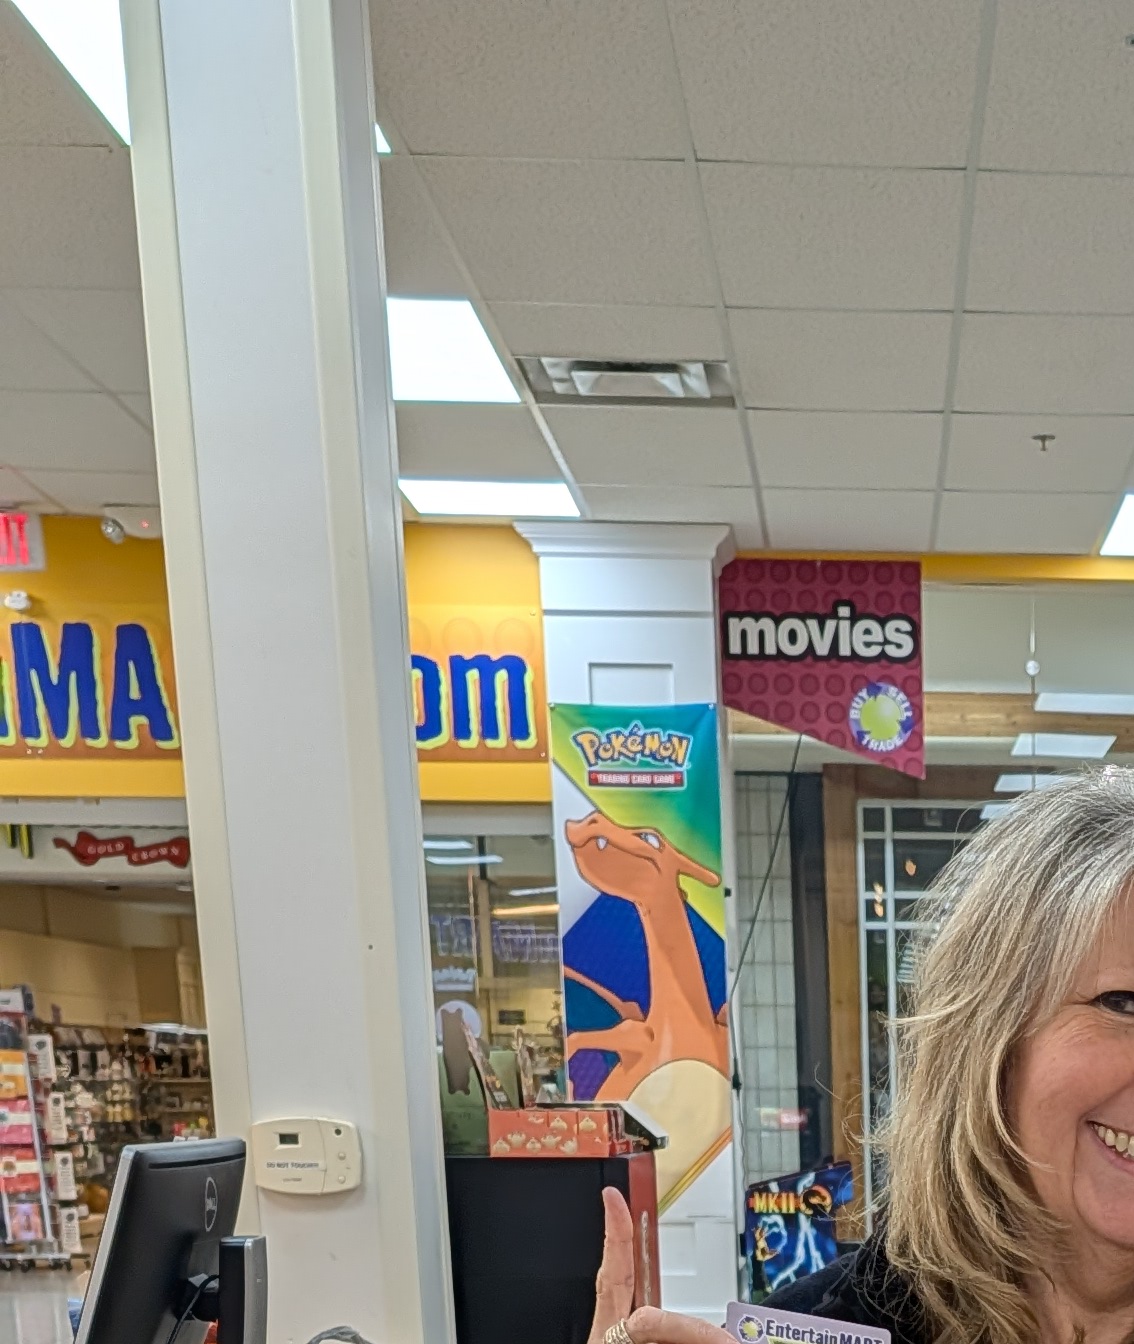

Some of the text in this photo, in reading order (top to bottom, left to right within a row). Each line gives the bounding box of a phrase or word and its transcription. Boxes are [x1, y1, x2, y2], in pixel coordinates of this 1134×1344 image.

[0, 513, 29, 564] IT
[728, 606, 914, 658] movies
[0, 621, 180, 749] MA
[850, 688, 870, 719] BUY
[888, 686, 913, 721] SELL
[861, 734, 904, 752] TRADE
